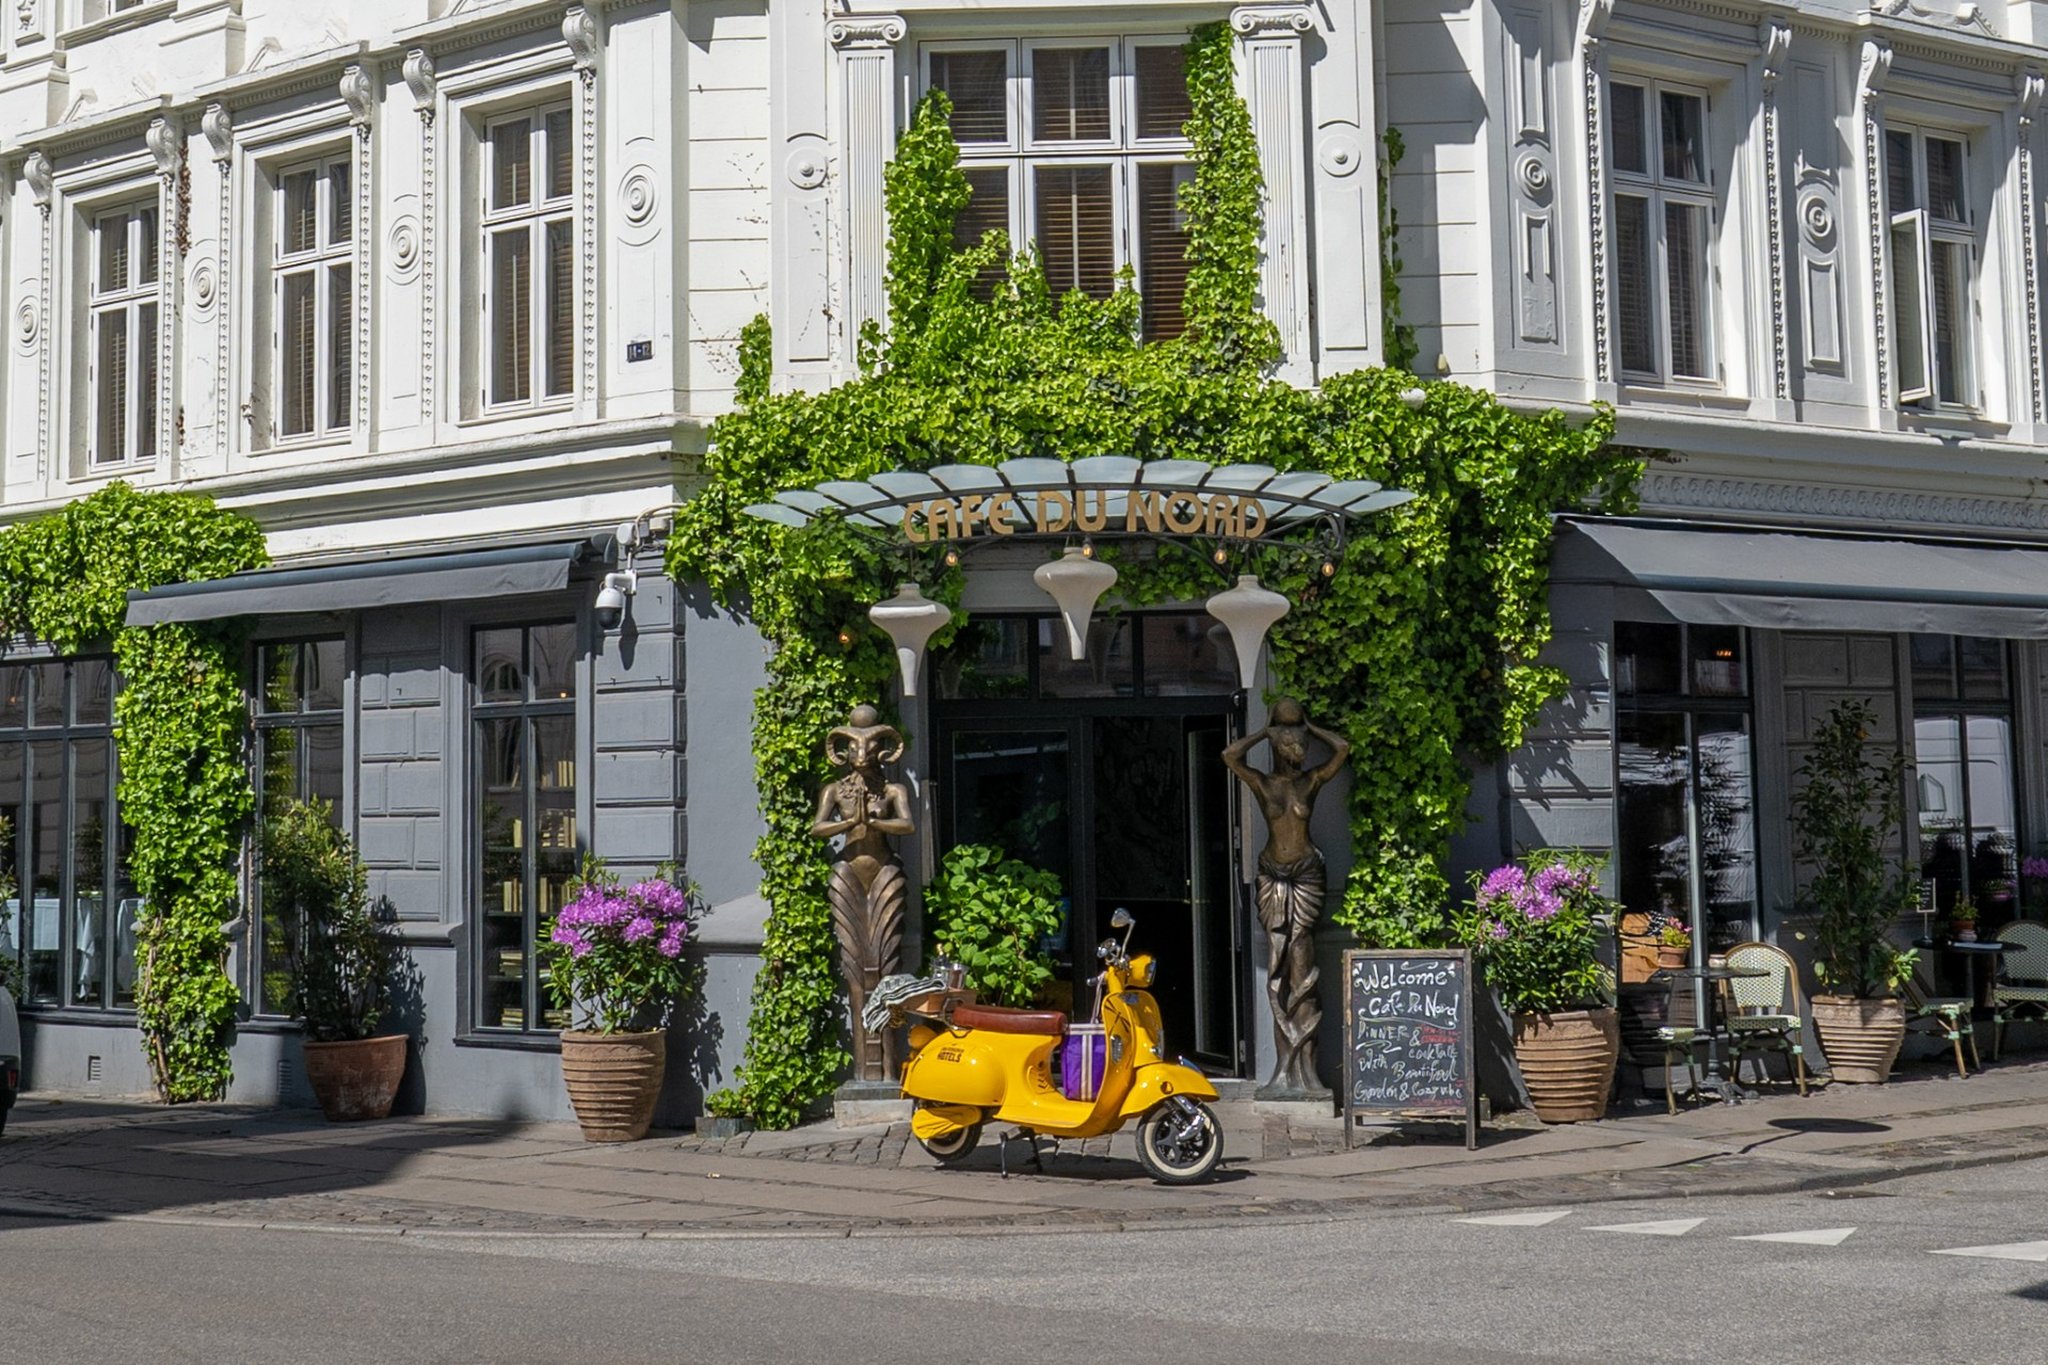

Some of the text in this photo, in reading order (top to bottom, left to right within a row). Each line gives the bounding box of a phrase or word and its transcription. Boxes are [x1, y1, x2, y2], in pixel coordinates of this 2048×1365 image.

[903, 489, 1267, 543] CAFE DU NORD
[1425, 990, 1459, 1021] Nord
[1408, 1027, 1423, 1047] &
[1398, 1081, 1410, 1102] &
